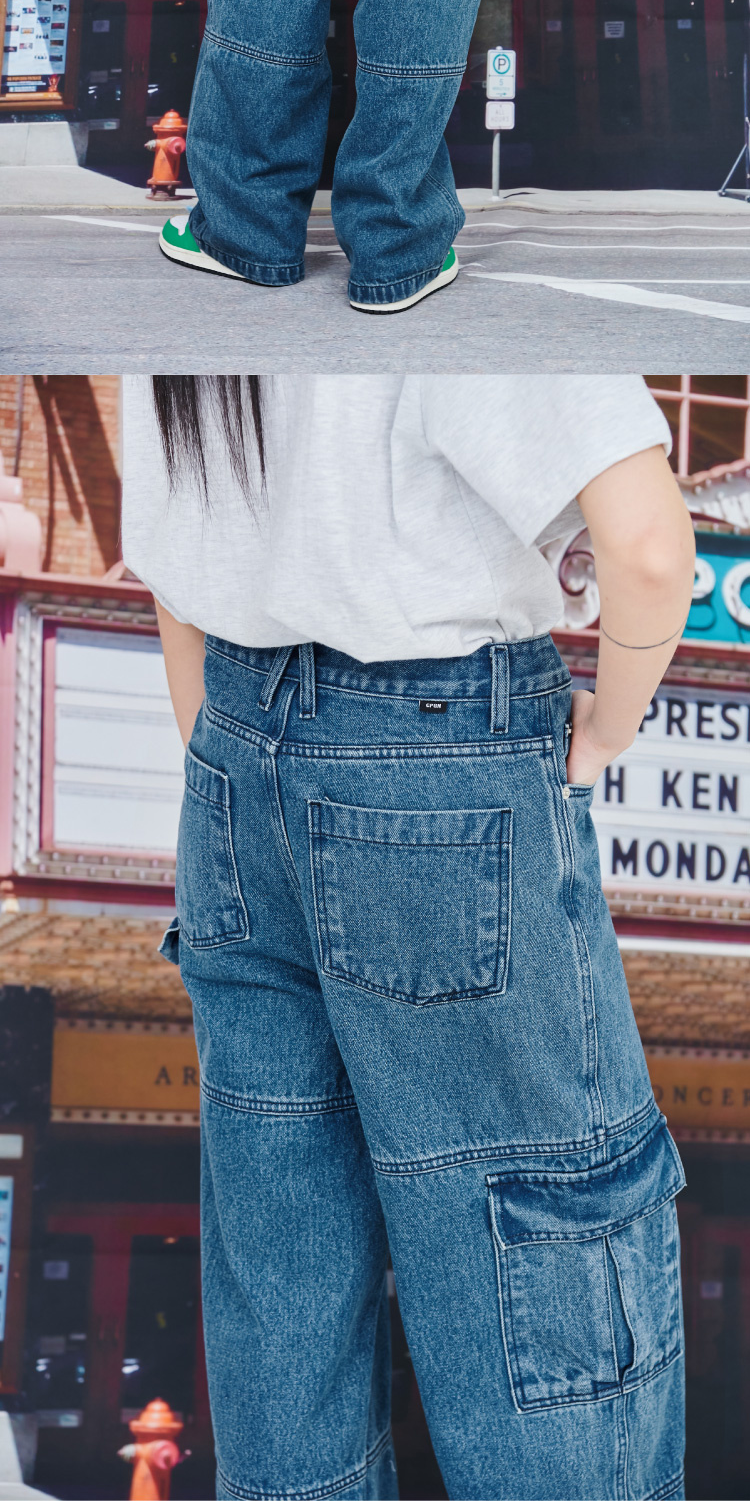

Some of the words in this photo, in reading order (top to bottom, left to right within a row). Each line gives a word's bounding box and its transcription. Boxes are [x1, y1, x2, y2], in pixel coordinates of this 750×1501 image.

[638, 699, 750, 743] PRES
[662, 769, 738, 813] KEN
[611, 838, 750, 884] MONDA
